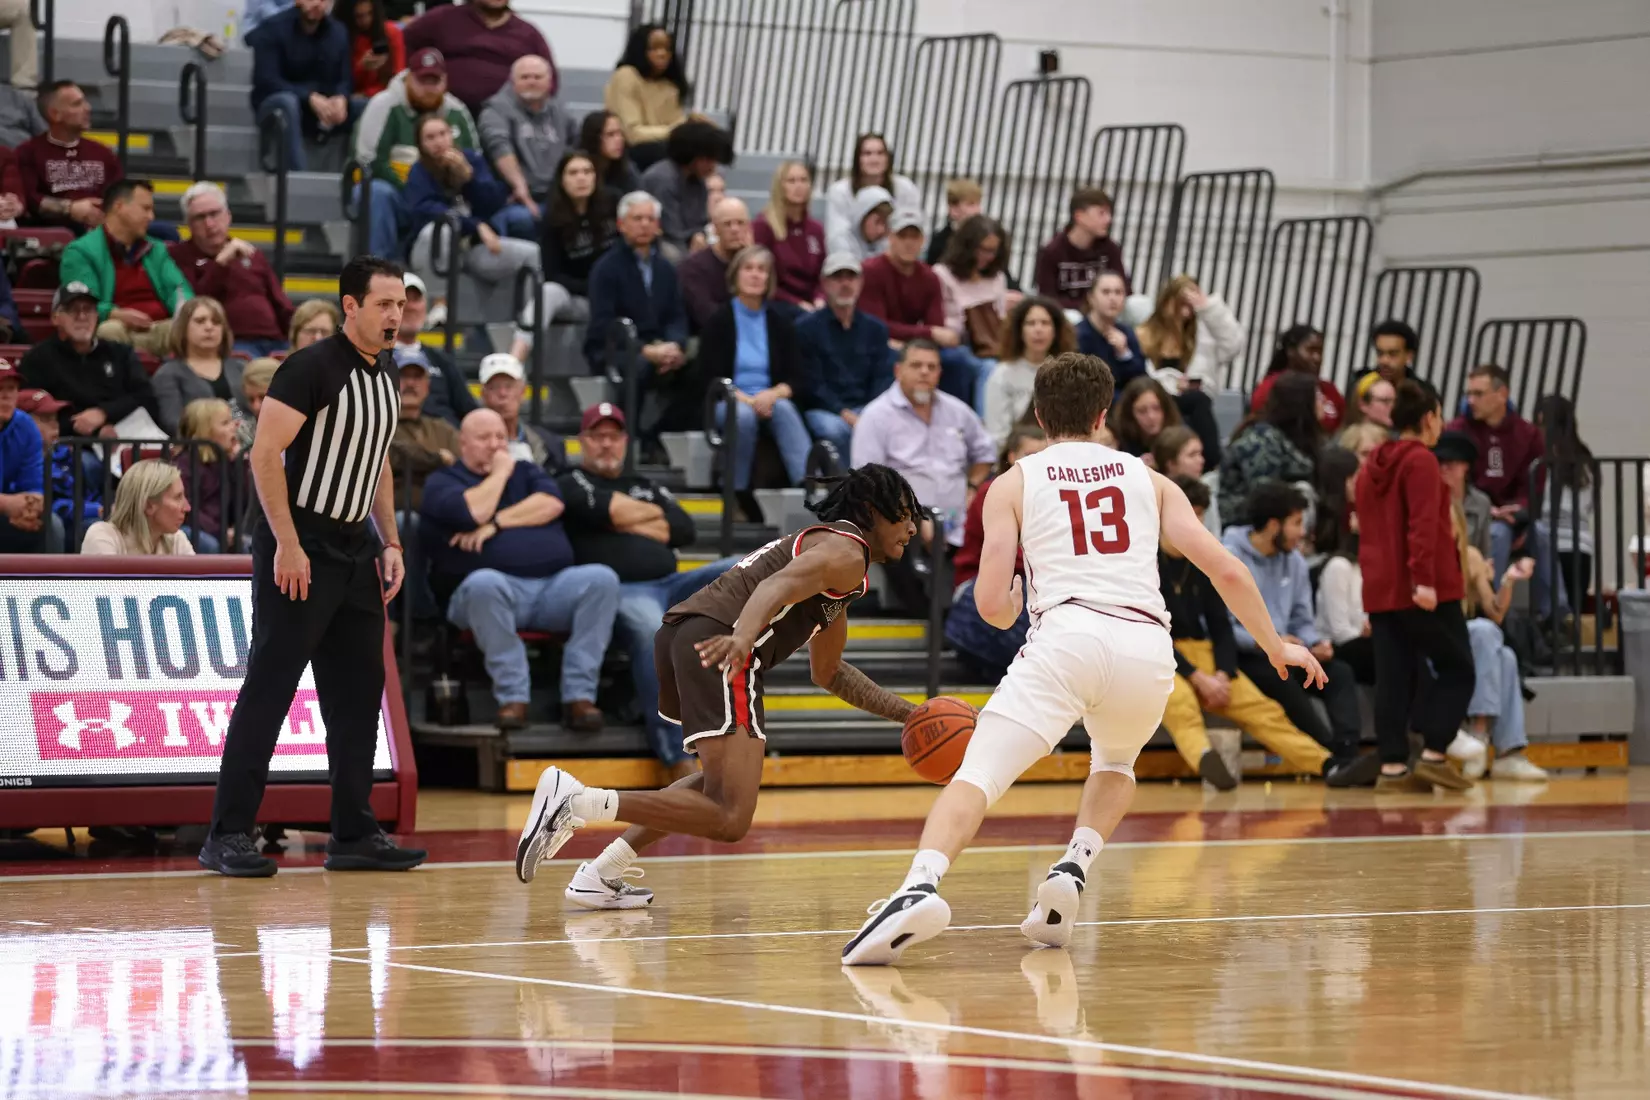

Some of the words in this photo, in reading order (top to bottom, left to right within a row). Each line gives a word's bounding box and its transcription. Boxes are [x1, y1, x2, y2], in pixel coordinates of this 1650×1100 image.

[1047, 463, 1125, 483] CARLESIMO
[1059, 486, 1130, 556] 13
[0, 595, 79, 681] IS
[95, 595, 250, 679] HOU
